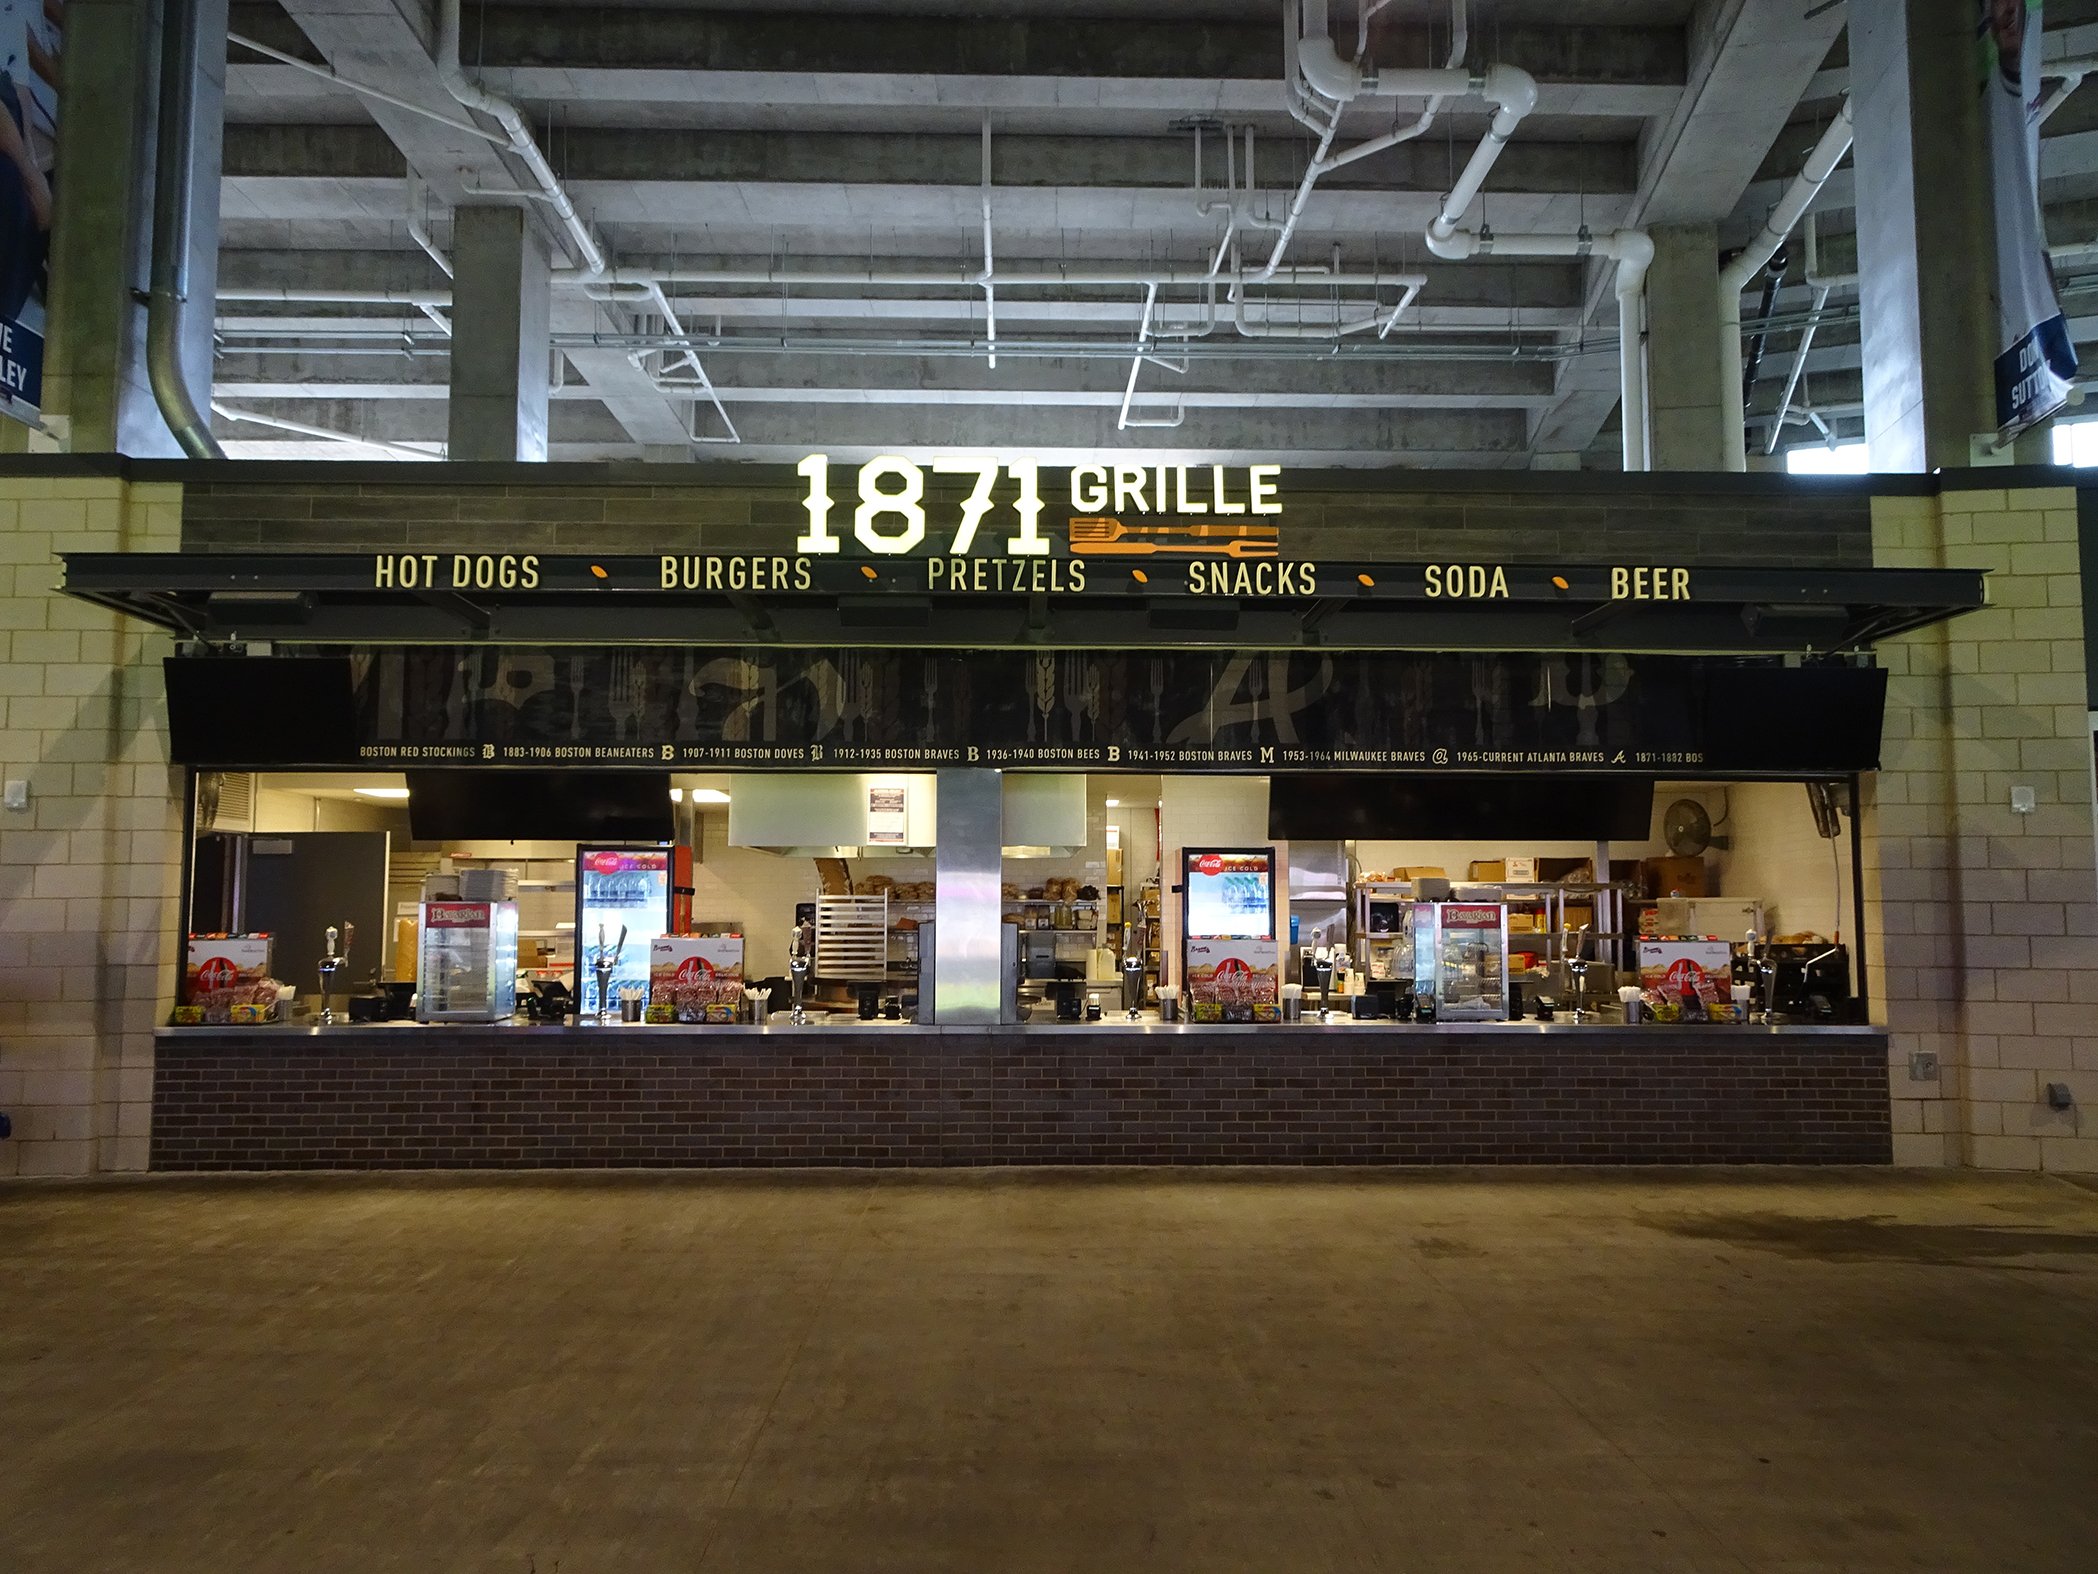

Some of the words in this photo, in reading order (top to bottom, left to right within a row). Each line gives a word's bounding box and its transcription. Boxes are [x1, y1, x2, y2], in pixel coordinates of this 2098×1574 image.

[797, 454, 1050, 555] 1871
[1070, 463, 1283, 514] GRILLE
[375, 555, 438, 588] HOT
[453, 555, 540, 589] DOGS
[660, 556, 812, 591] BURGERS
[927, 557, 1086, 592] PRETZELS
[1188, 561, 1317, 596] SNACKS
[1424, 565, 1510, 598] SODA
[1611, 567, 1691, 600] BEER
[360, 746, 397, 757] BOSTON
[400, 746, 419, 757] RED
[422, 746, 475, 758] STOCKINGS
[503, 747, 551, 757] 1883-1906
[555, 747, 592, 758] BOSTON
[595, 747, 654, 758] BEANEATERS
[683, 748, 731, 758] 1907-1911
[735, 748, 771, 759] BOSTON
[774, 748, 804, 758] DOVES
[833, 748, 882, 759] 1912-1935
[885, 748, 921, 759] BOSTON
[924, 749, 960, 759] BRAVES
[987, 749, 1034, 760] 1936-1940
[1038, 749, 1075, 759] BOSTON
[1077, 749, 1100, 759] BEES
[1128, 750, 1176, 761] 1941-1952
[1179, 750, 1215, 761] BOSTON
[1218, 750, 1252, 761] BRAVES
[1283, 751, 1331, 761] 1953-1964
[1334, 751, 1388, 762] MILWAUKEE
[1391, 751, 1426, 762] BRAVES
[1456, 751, 1524, 762] 1965-CURRENT
[1527, 752, 1566, 763] ATLANTA
[1569, 752, 1605, 762] BRAVES
[1636, 752, 1683, 763] 1871-1882
[1686, 752, 1704, 763] BOS
[594, 857, 618, 866] Coca-Cola
[1199, 859, 1222, 868] Coca-Cola
